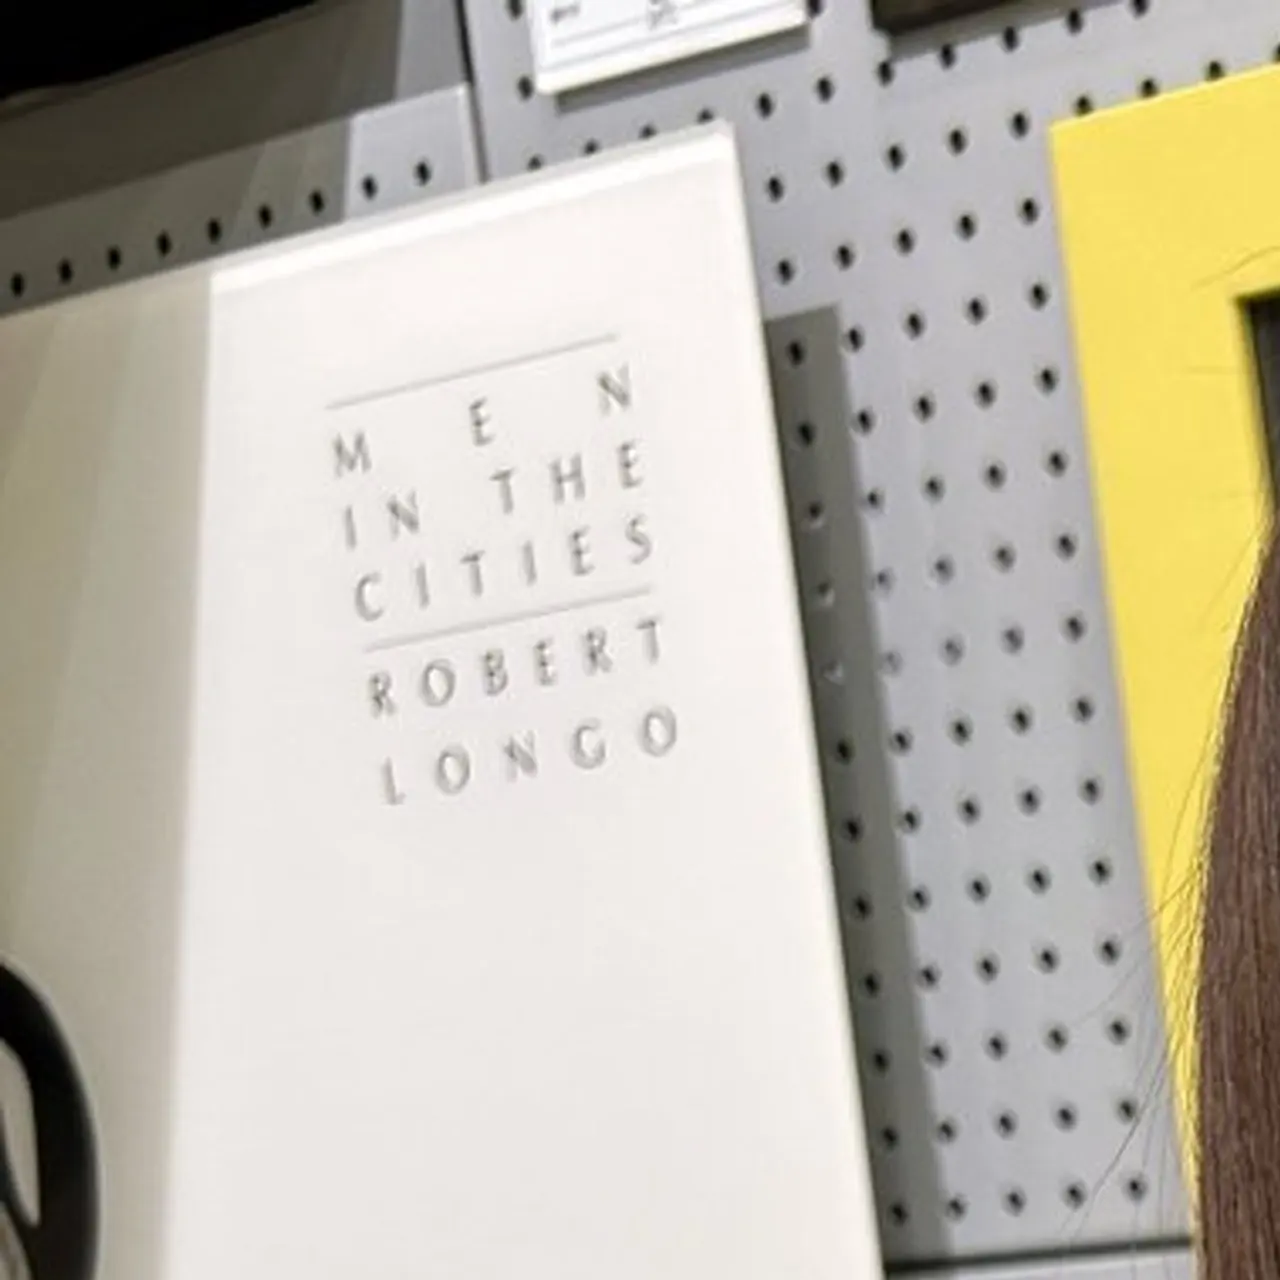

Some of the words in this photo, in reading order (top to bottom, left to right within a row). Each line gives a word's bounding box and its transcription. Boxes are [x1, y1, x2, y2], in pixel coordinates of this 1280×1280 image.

[332, 363, 632, 478] MEN
[343, 490, 420, 550] IN
[490, 438, 644, 514] THE
[354, 513, 652, 623] CITIES
[368, 614, 663, 719] ROBERT
[380, 704, 678, 806] LONGO
